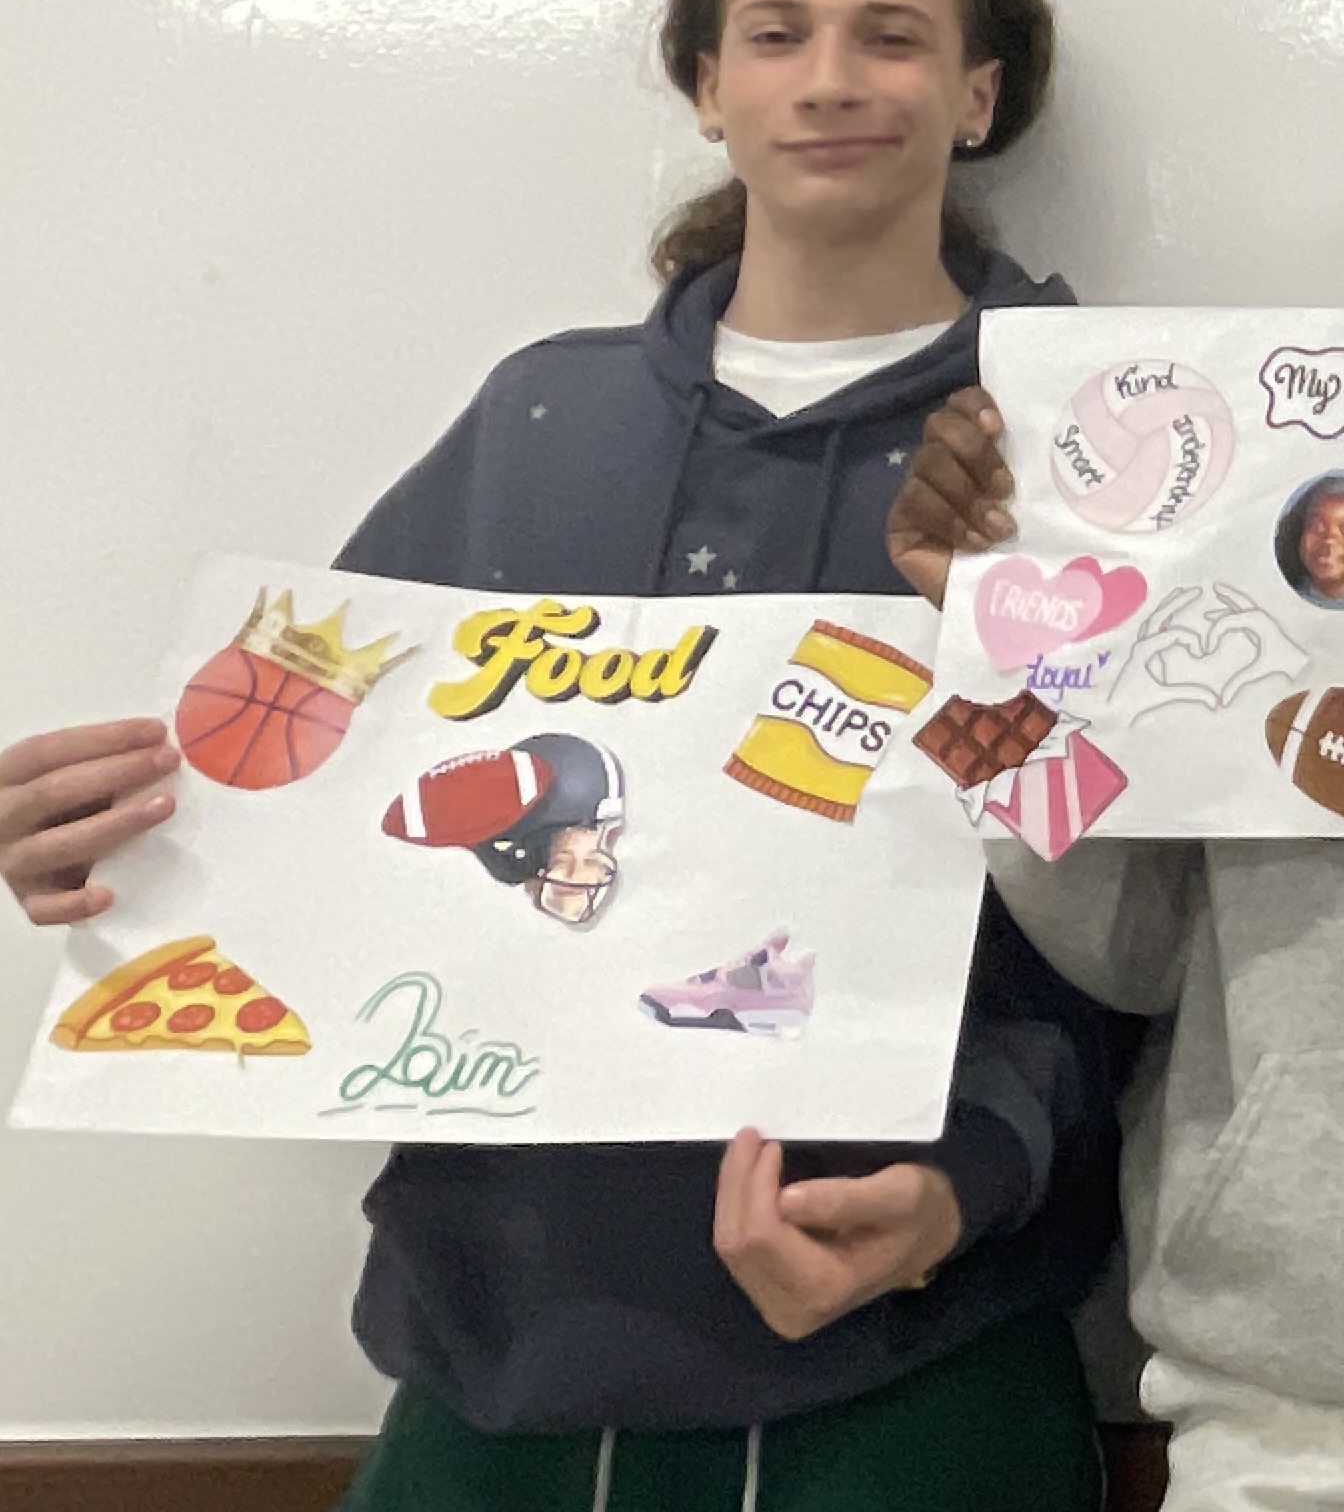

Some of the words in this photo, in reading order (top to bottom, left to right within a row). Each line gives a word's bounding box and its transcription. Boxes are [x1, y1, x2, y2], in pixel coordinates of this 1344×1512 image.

[1114, 362, 1180, 400] Kind
[1274, 362, 1342, 416] My
[989, 578, 1085, 633] FRIENDS
[426, 596, 720, 724] Food
[769, 676, 894, 756] CHIPS
